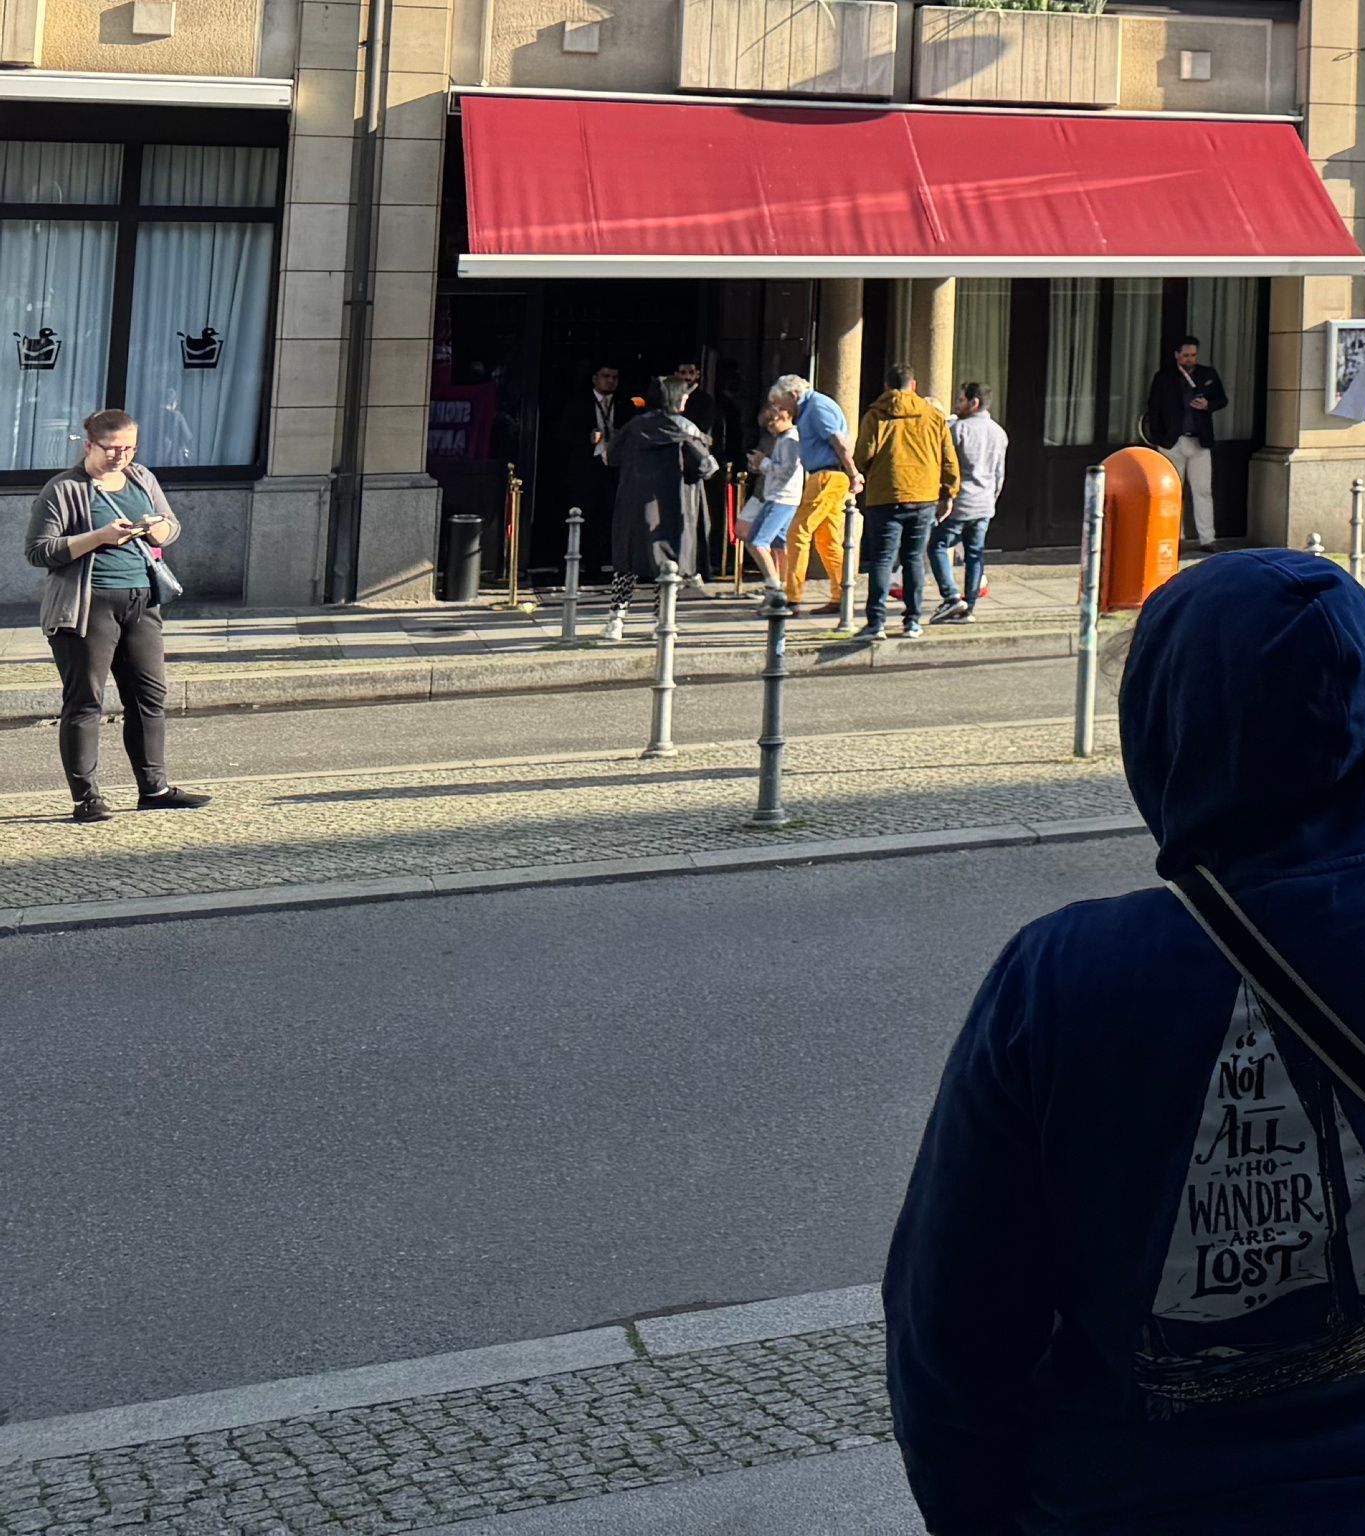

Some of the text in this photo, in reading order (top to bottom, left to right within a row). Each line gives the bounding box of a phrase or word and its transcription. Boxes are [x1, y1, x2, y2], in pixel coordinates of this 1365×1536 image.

[1194, 1105, 1305, 1164] ALL
[1187, 1172, 1324, 1236] WANDER
[1190, 1231, 1312, 1300] LOST
